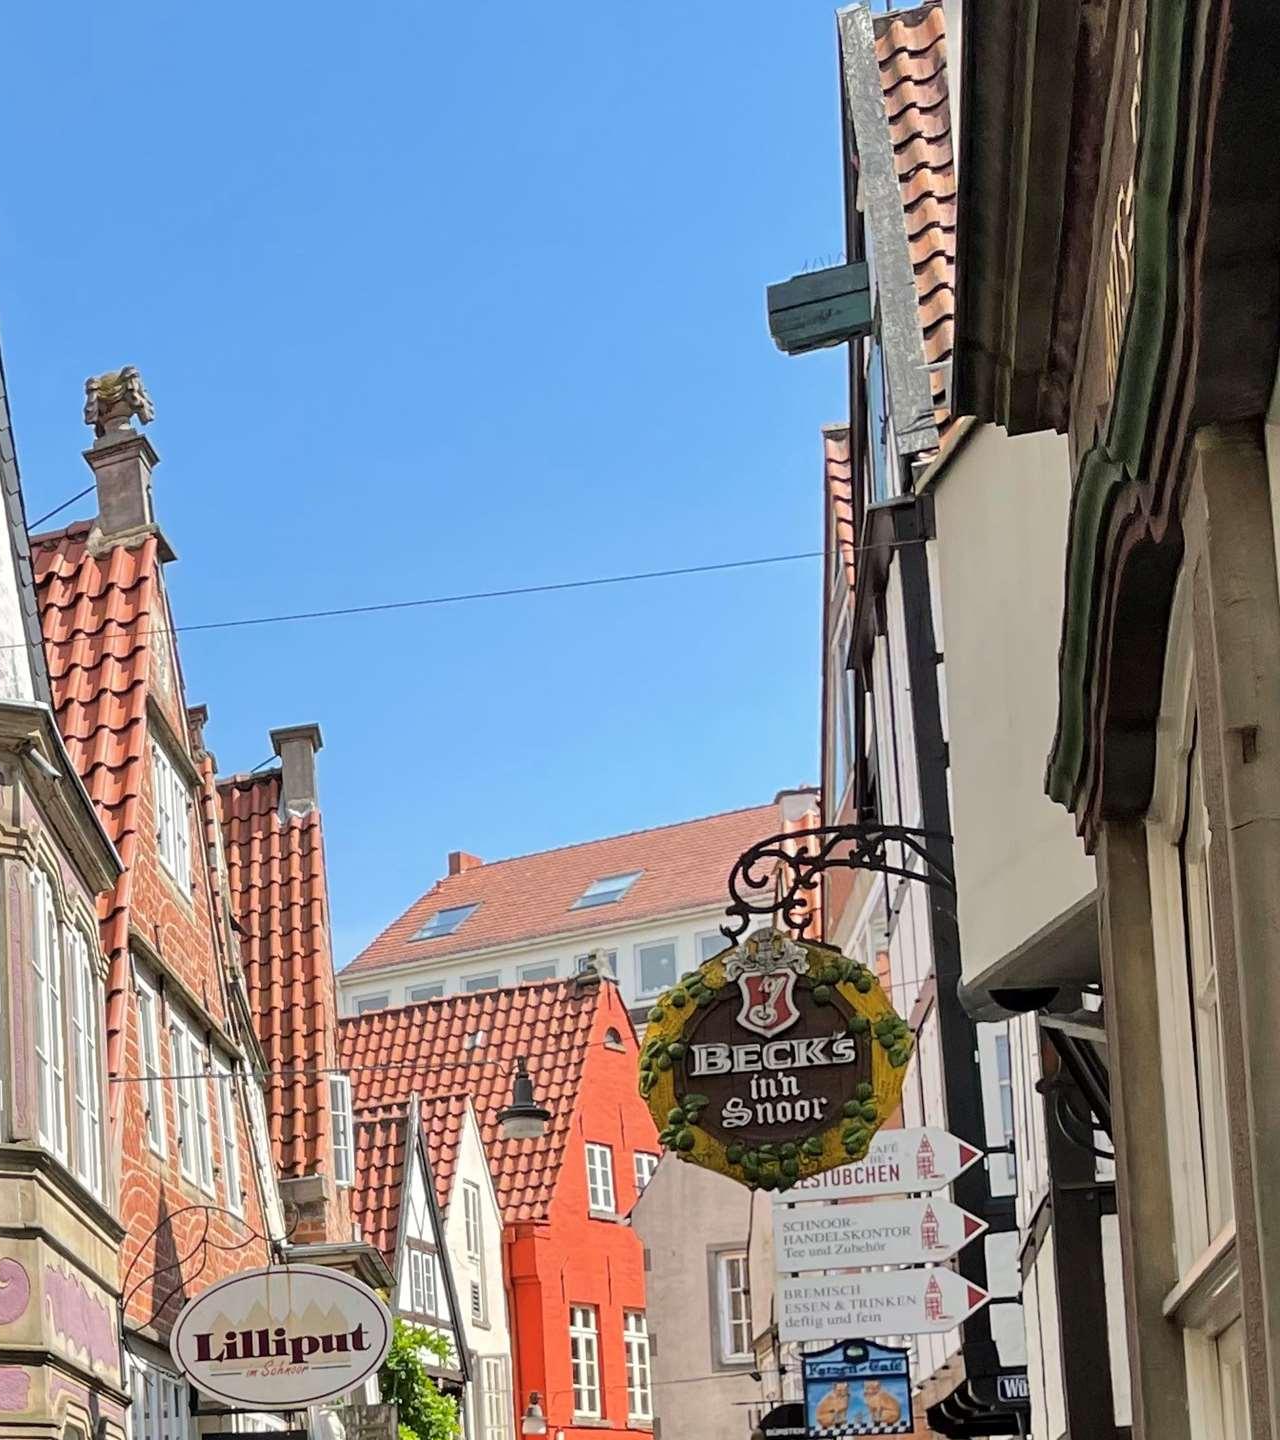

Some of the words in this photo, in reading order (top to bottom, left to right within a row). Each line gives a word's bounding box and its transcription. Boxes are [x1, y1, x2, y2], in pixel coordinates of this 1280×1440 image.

[722, 1097, 828, 1128] Snoor
[783, 1226, 912, 1246] HANDELSKONTOR
[785, 1247, 805, 1258] Tee
[809, 1246, 831, 1257] und
[835, 1242, 887, 1255] Zubehör
[784, 1284, 861, 1300] BREMISCH
[785, 1301, 830, 1314] ESSEN
[835, 1300, 846, 1311] &
[849, 1296, 917, 1310] TRINKEN
[785, 1315, 824, 1329] deftig
[827, 1313, 852, 1325] und
[856, 1312, 882, 1324] fein
[193, 1322, 372, 1364] Lilliput
[246, 1367, 257, 1377] im
[262, 1361, 309, 1377] Schnoor
